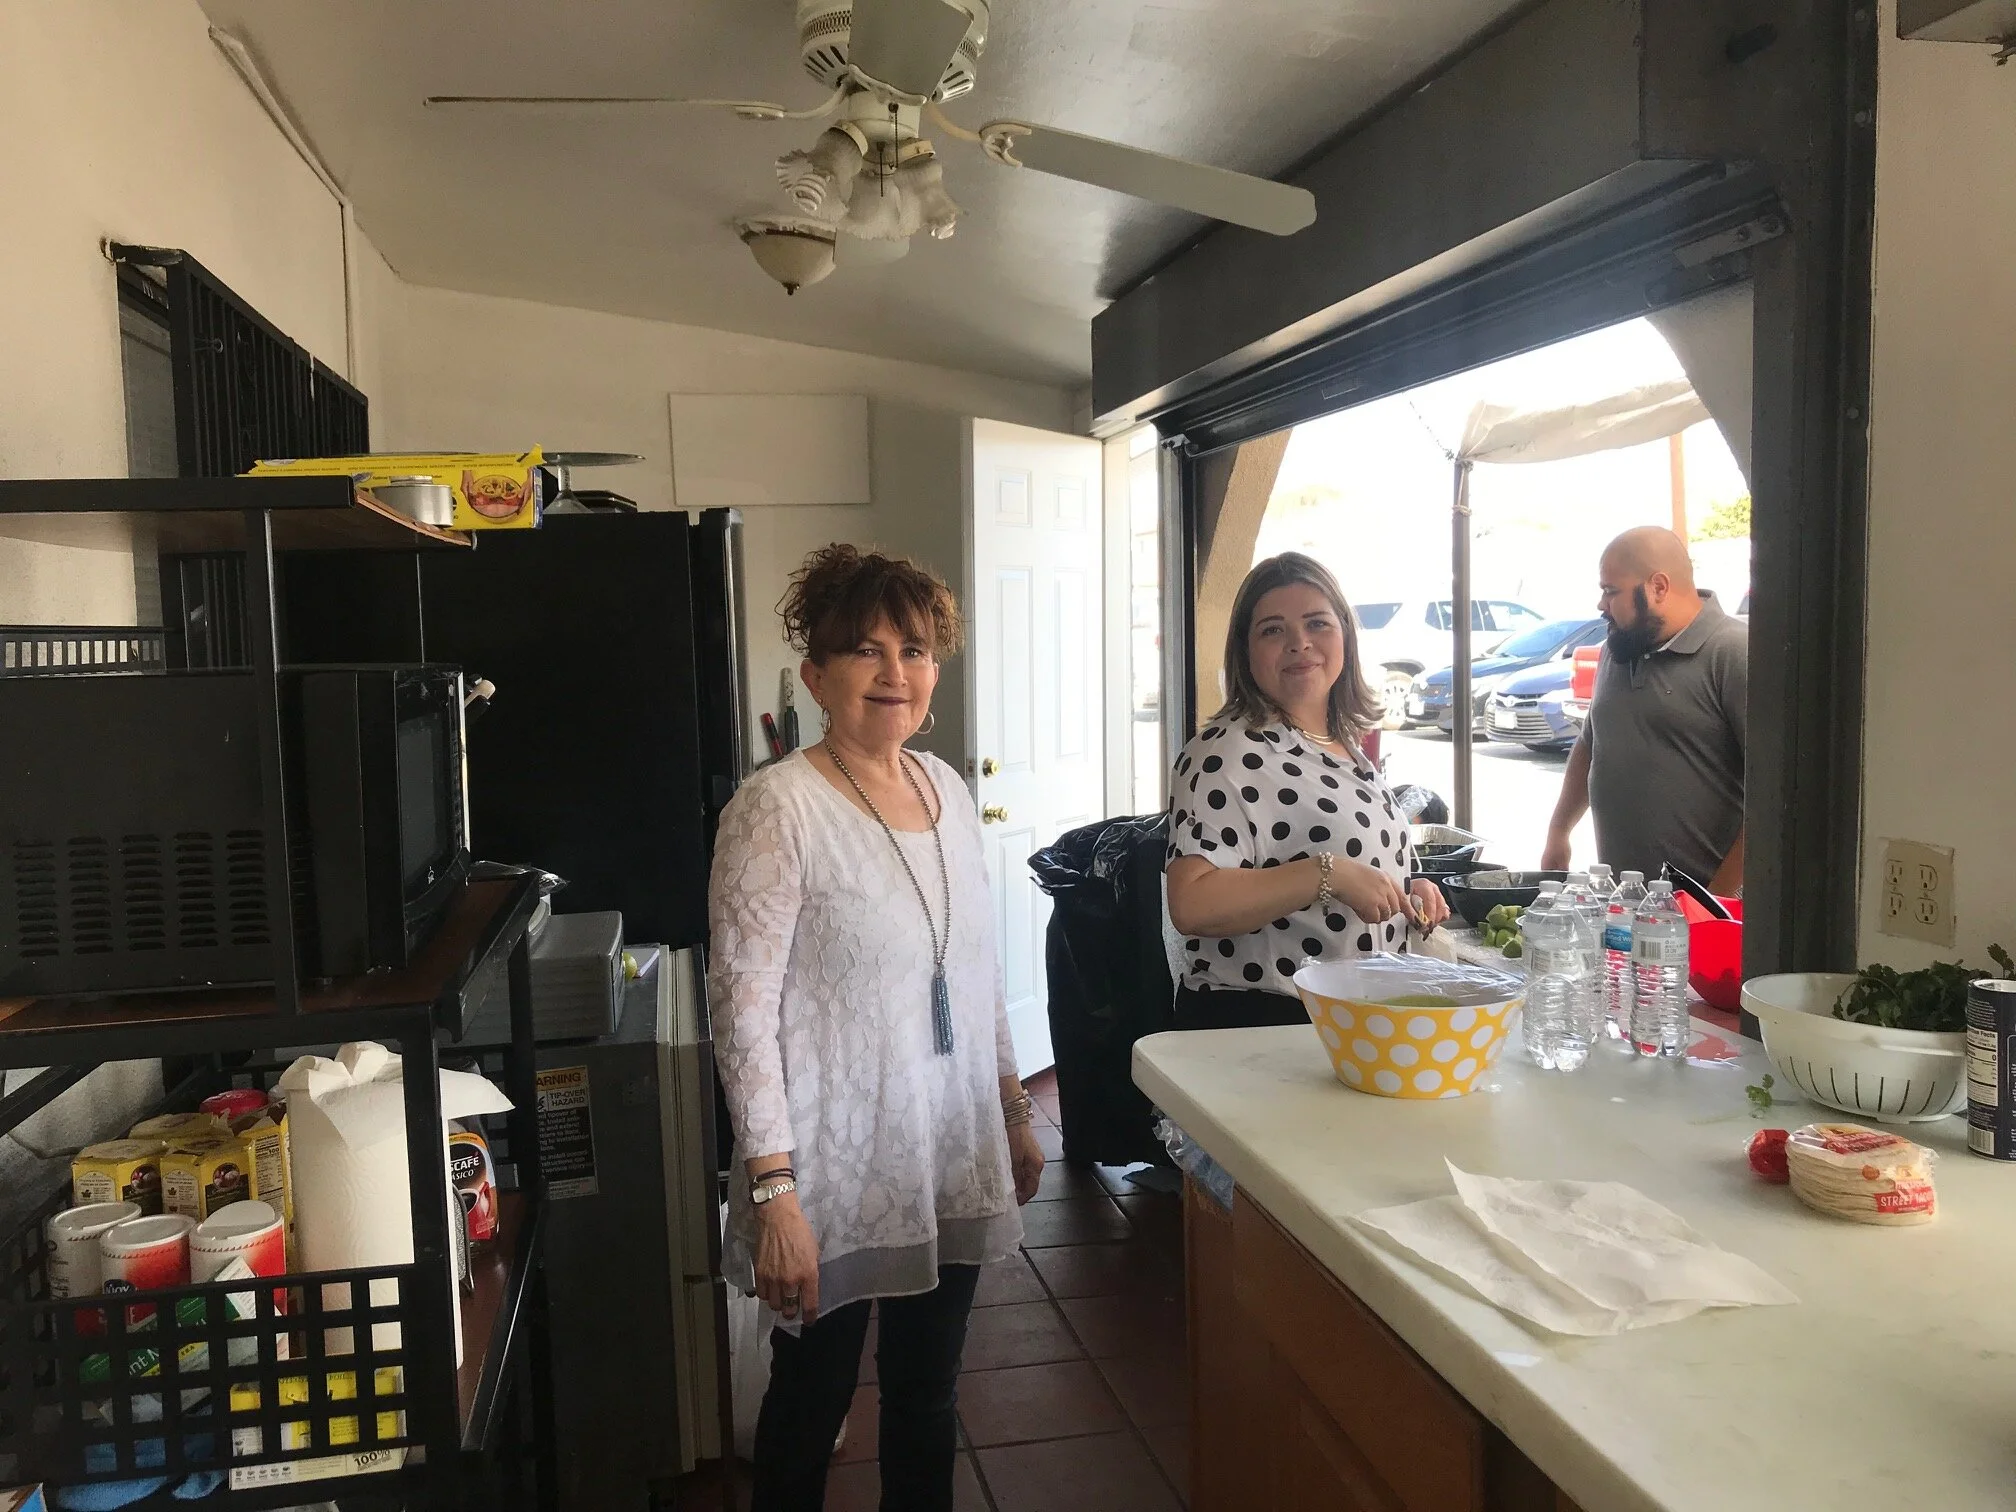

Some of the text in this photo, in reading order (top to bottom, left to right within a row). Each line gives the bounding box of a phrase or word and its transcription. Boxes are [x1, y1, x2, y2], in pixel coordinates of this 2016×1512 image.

[536, 1072, 581, 1086] ARNING
[549, 1088, 586, 1099] TIP-OVER
[551, 1096, 585, 1106] HAZARD
[450, 1152, 480, 1172] SCAFÉ
[452, 1169, 475, 1181] SICO
[354, 1449, 391, 1466] 100%
